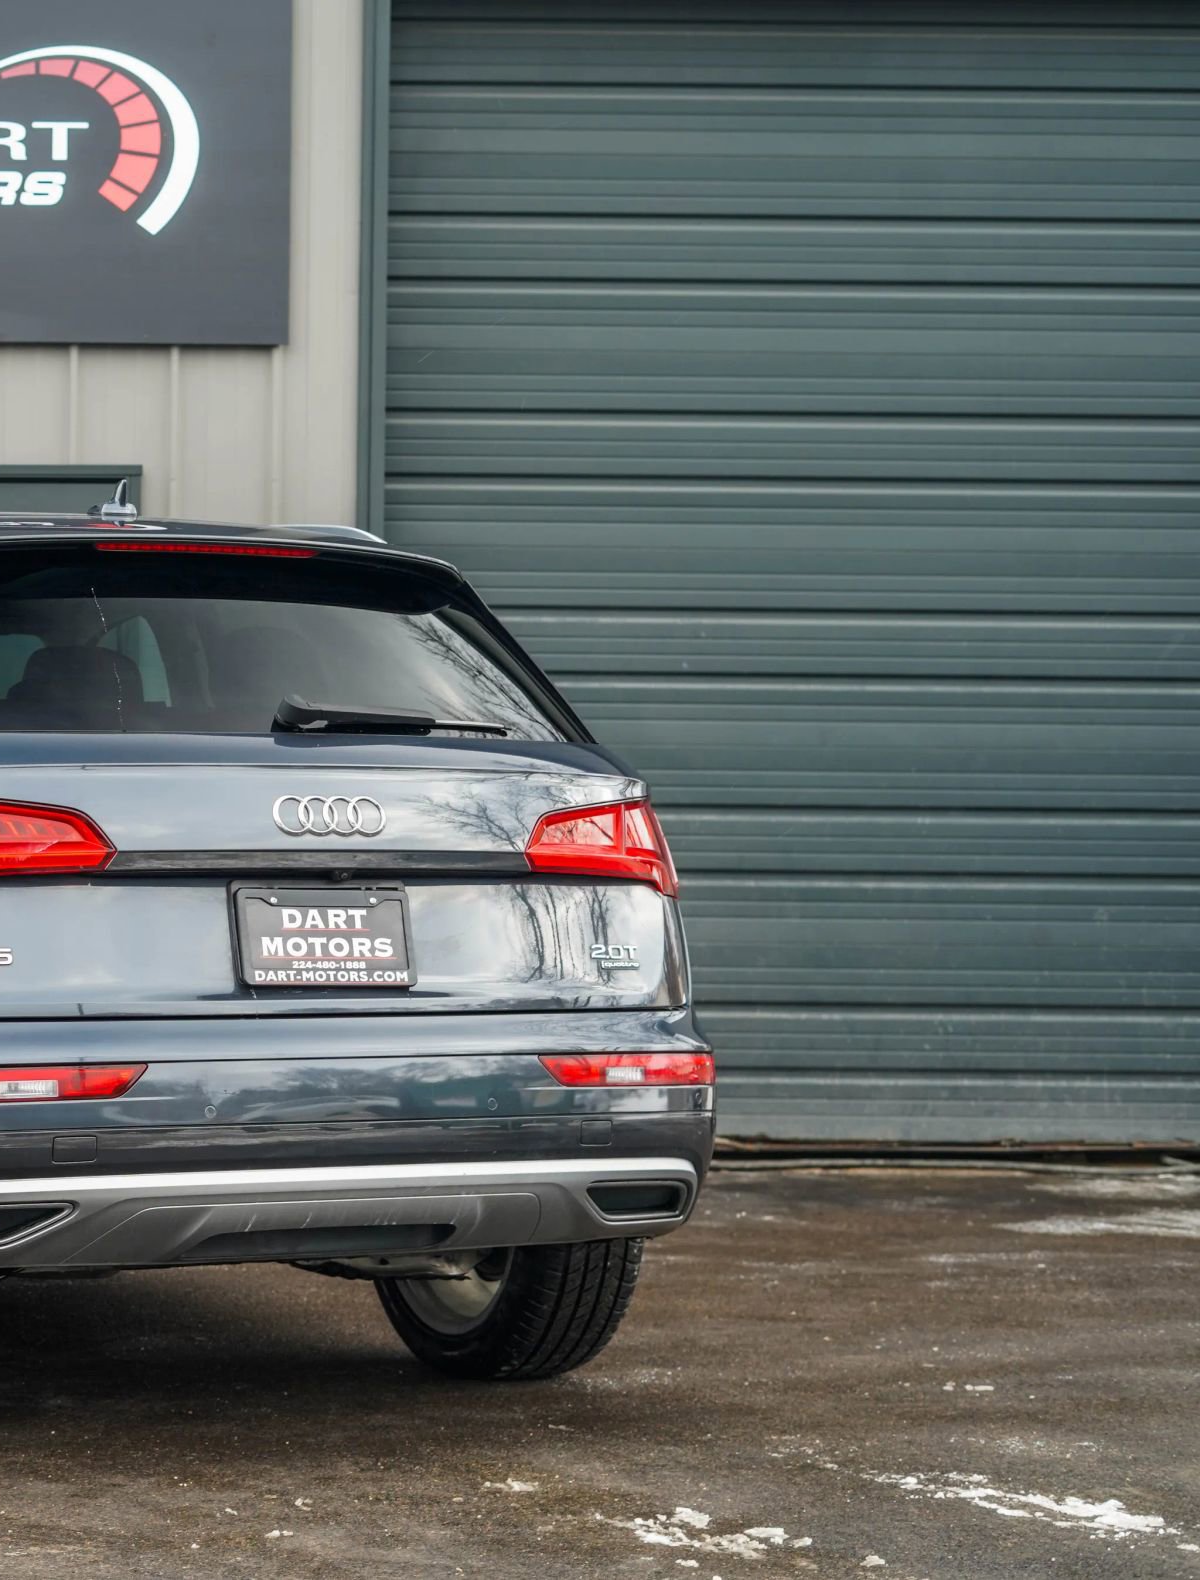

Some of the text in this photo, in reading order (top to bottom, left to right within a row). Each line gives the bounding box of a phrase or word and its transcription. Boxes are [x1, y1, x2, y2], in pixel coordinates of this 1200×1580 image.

[281, 908, 367, 929] DART
[260, 936, 394, 958] MOTORS
[591, 944, 638, 959] 2.0T
[292, 960, 367, 969] 224-480-1888
[604, 960, 640, 968] quattro
[254, 970, 409, 982] DART-MOTORS.COM
